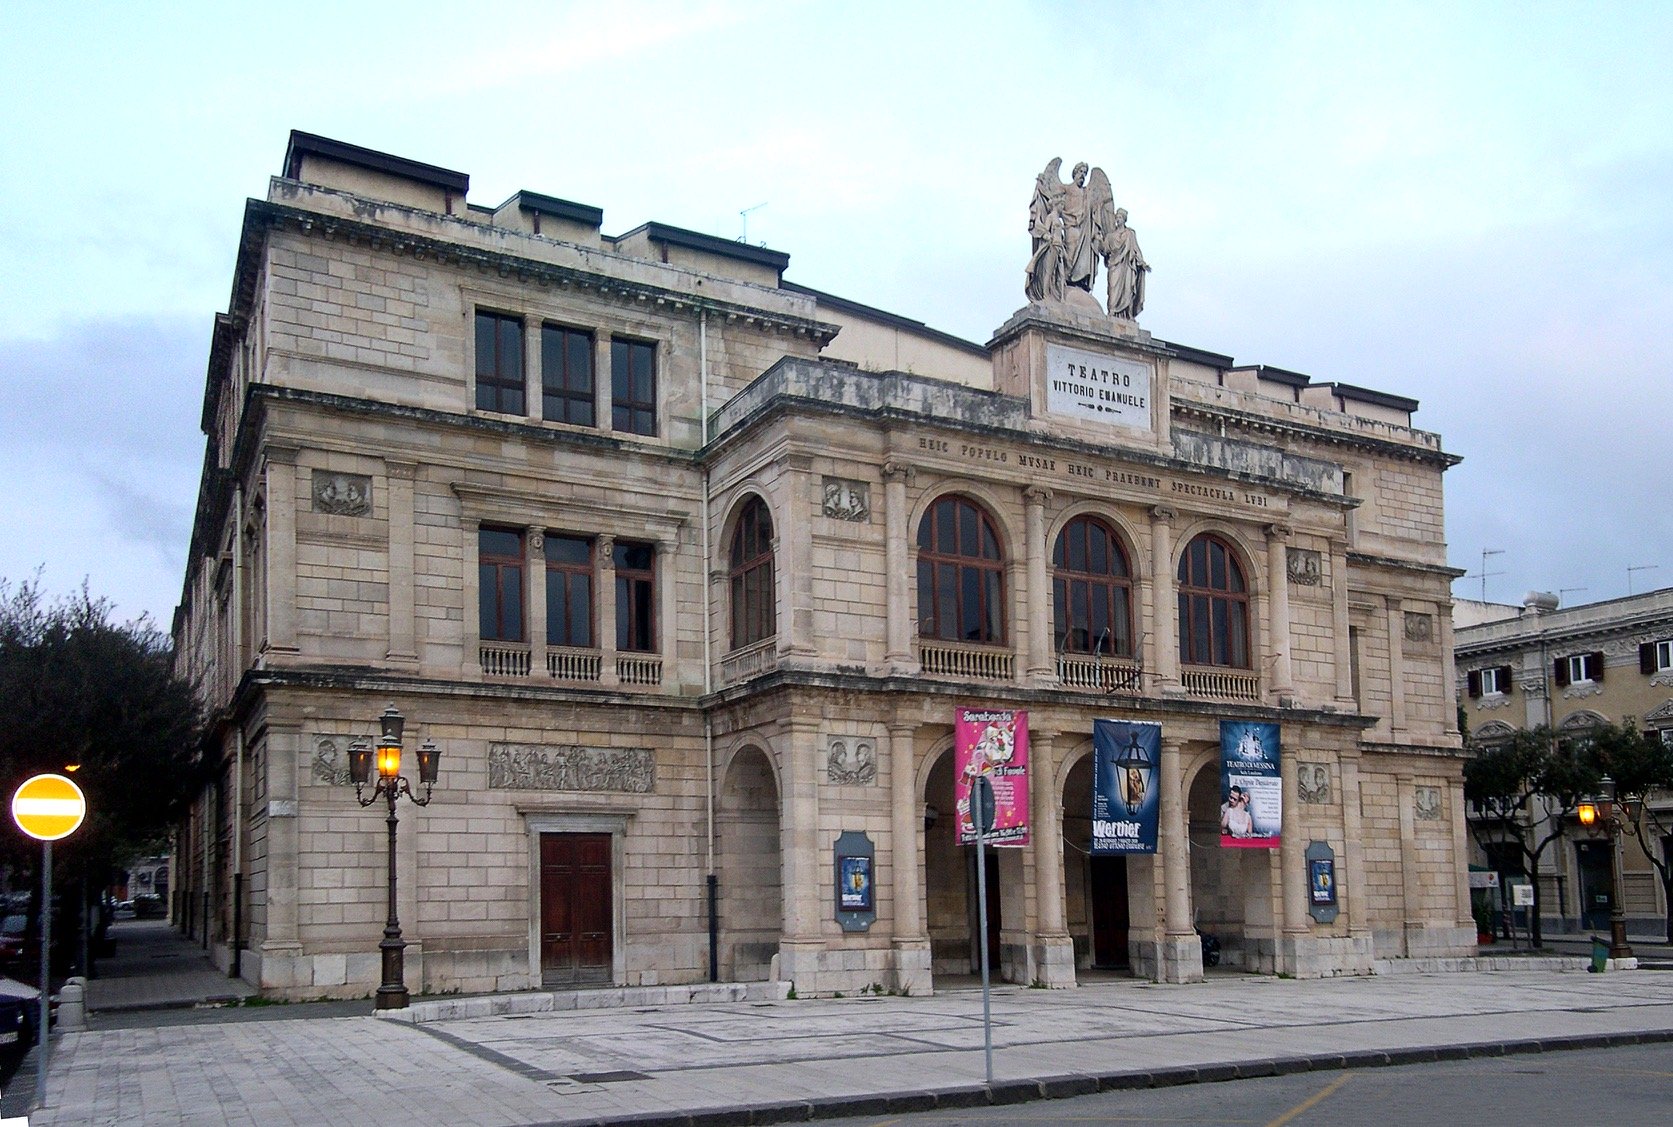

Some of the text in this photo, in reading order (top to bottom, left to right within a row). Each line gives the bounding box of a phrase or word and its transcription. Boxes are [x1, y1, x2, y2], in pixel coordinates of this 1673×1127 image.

[1067, 363, 1130, 387] TEATRO
[1053, 380, 1145, 408] VITTORIO EMANUELE
[919, 437, 948, 453] HEIC
[961, 445, 1007, 463] POPVLO
[1018, 454, 1056, 471] MVSAE
[1068, 464, 1094, 478] HEIC
[1105, 469, 1161, 489] PRAEBENT
[1172, 481, 1235, 501] SPECTACVLA
[1092, 820, 1142, 838] Werther
